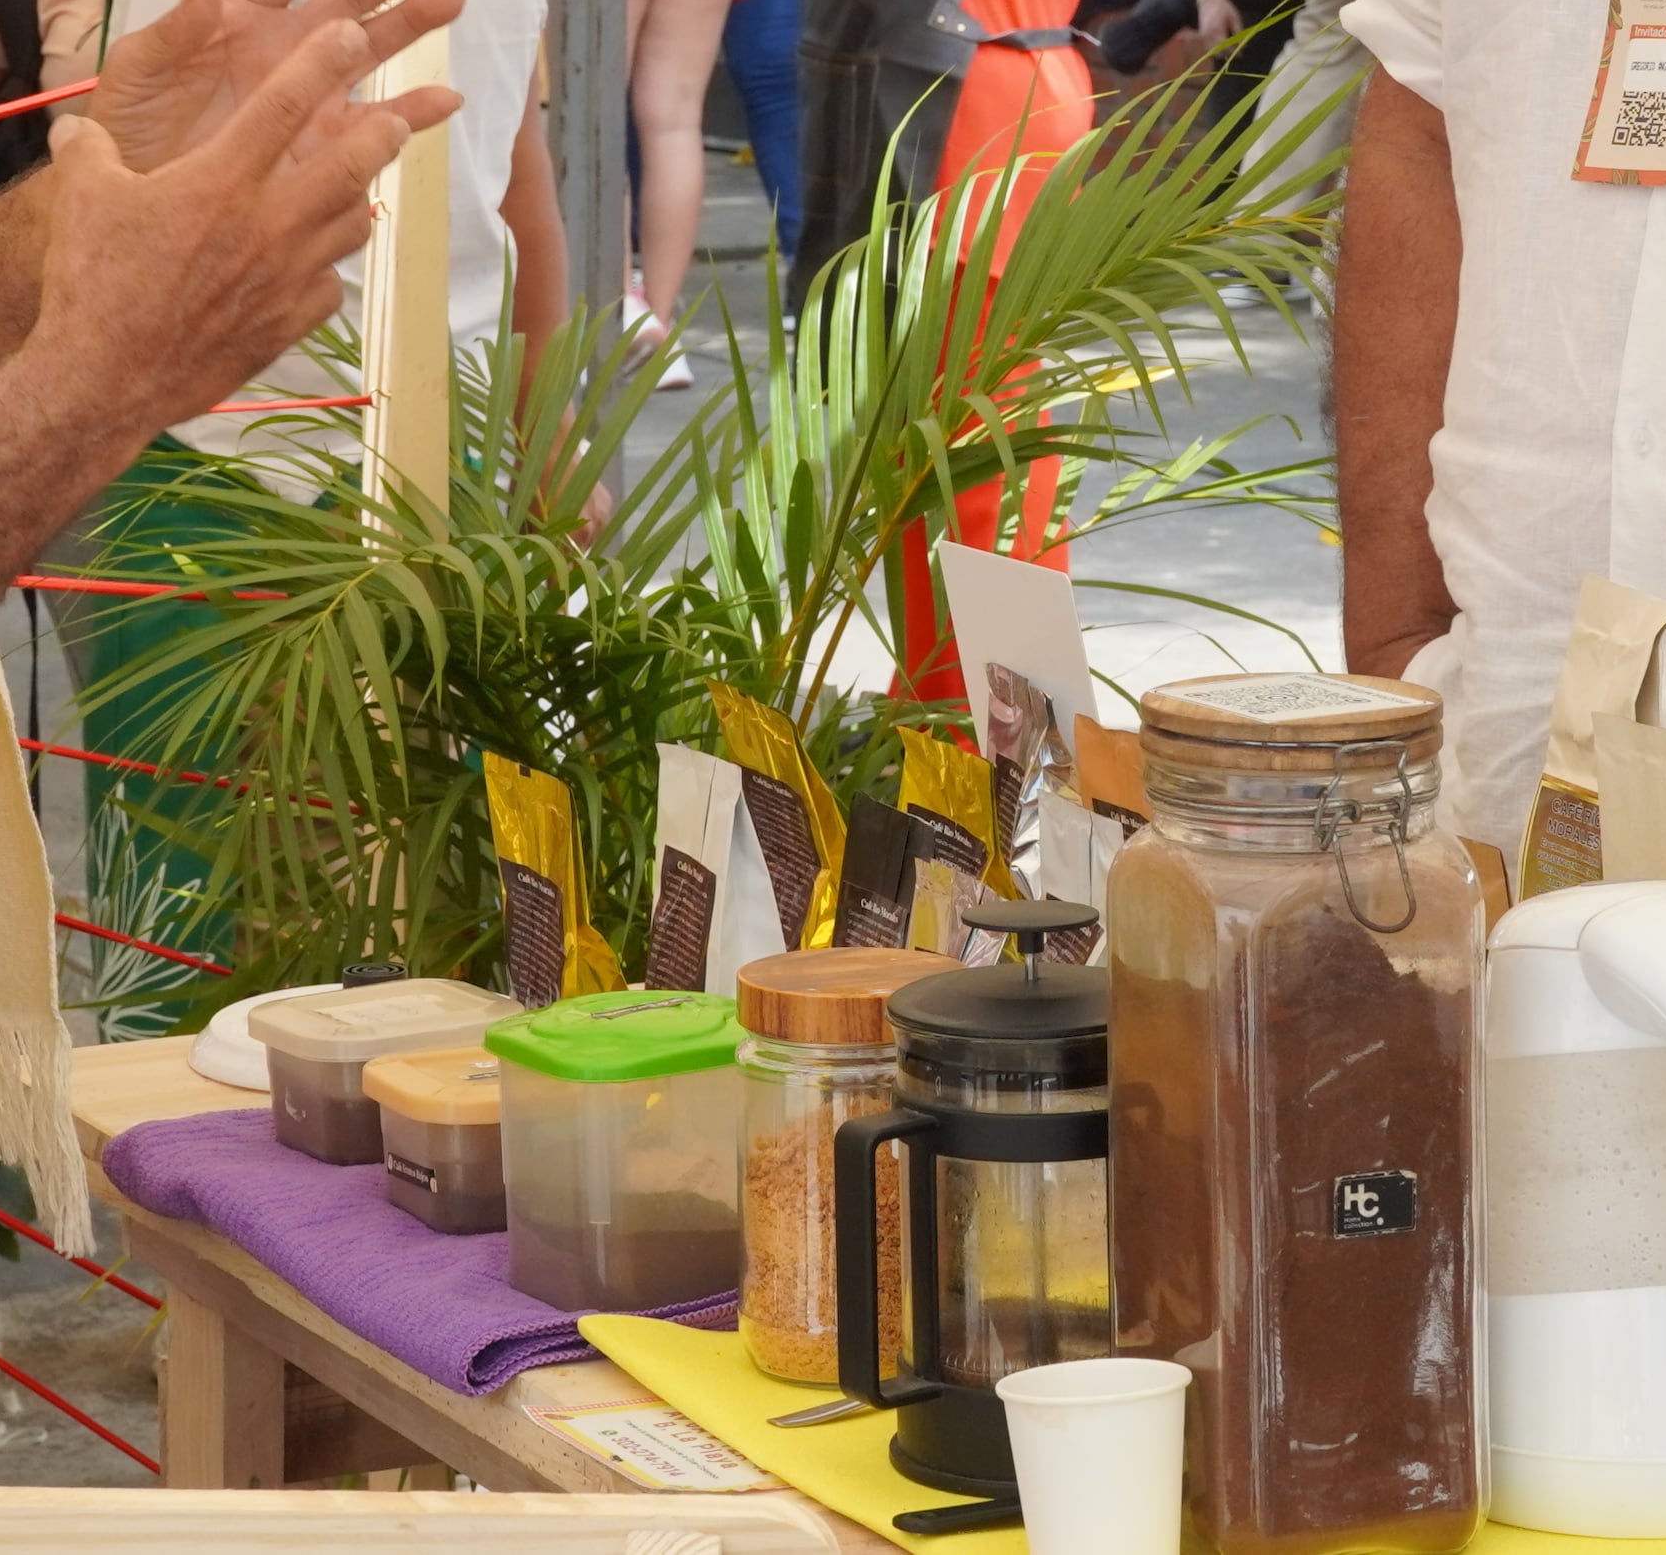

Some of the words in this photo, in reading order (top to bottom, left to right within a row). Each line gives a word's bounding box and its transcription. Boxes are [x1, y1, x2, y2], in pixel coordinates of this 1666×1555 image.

[1552, 797, 1584, 822] CAFÉ
[1547, 817, 1601, 851] MORALES
[671, 1431, 697, 1444] La
[692, 1442, 740, 1471] Playa
